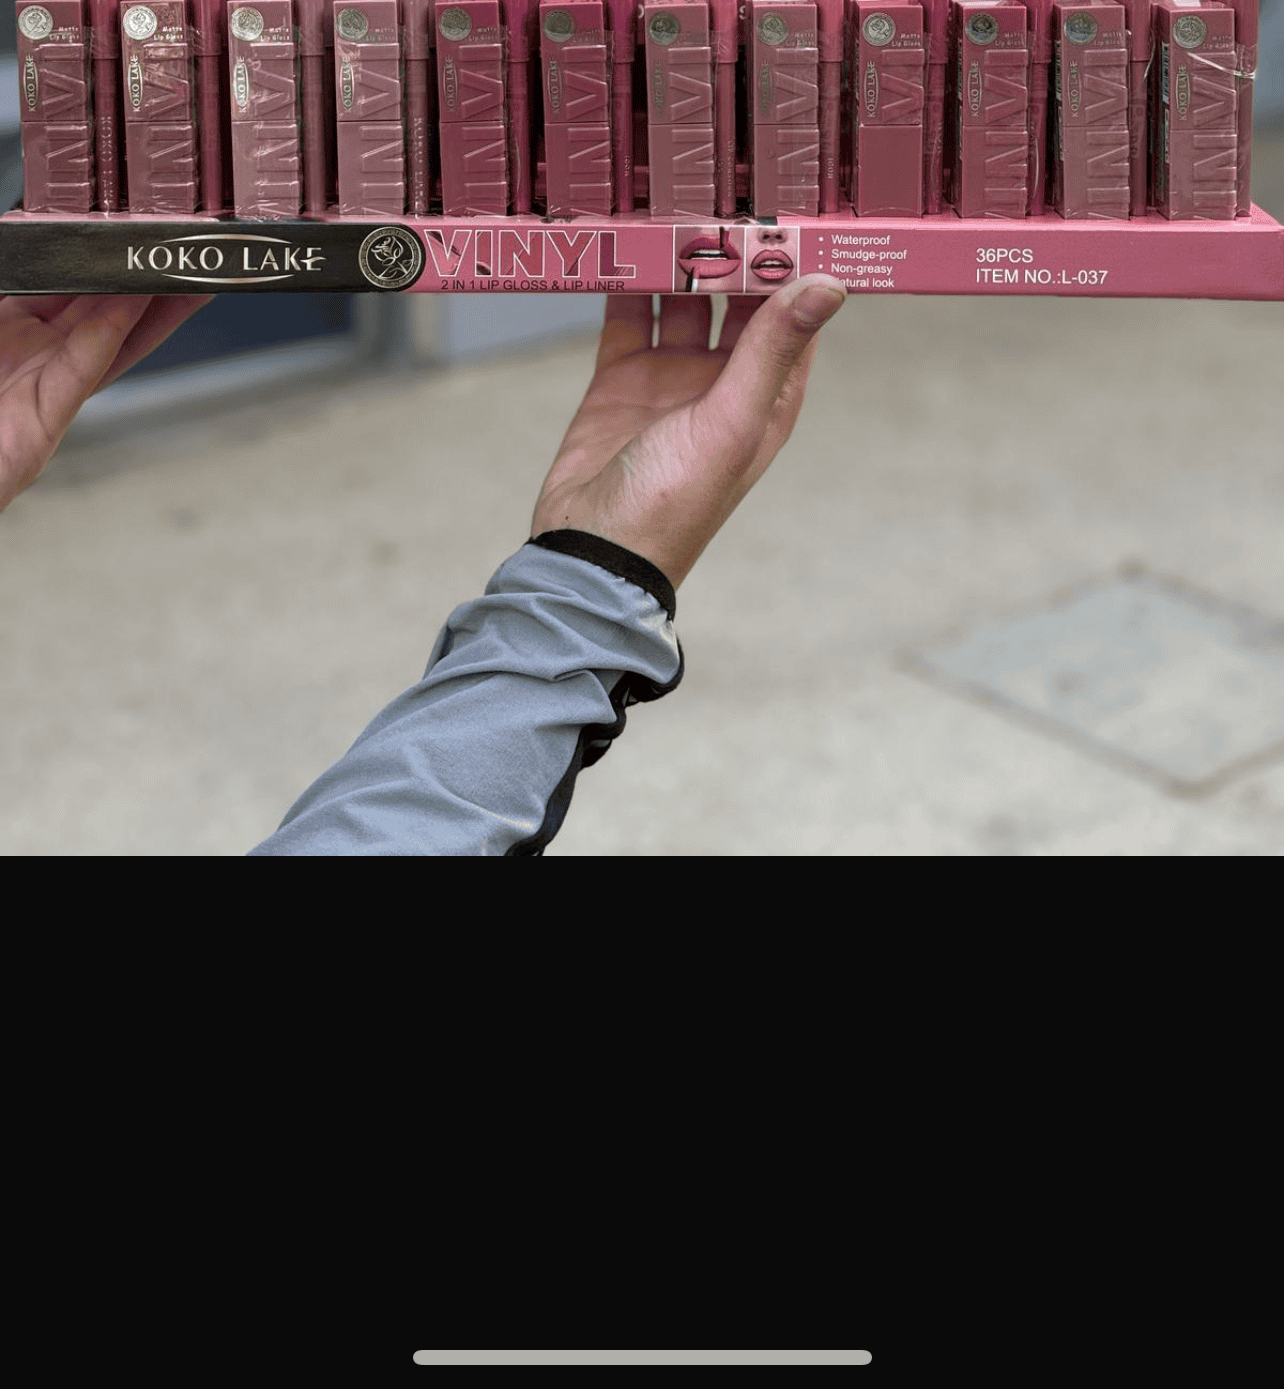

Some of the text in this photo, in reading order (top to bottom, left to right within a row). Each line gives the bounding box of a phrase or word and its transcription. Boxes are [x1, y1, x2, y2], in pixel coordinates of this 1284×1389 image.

[25, 54, 36, 112] KOKO LAKE
[129, 54, 140, 112] KOKO LAKE
[866, 60, 876, 118] KOKO LAKE
[970, 59, 979, 118] KOKO LAKE
[1069, 61, 1079, 118] KOKO LAKE
[1177, 64, 1188, 121] KOKO LAKE
[831, 234, 890, 246] Waterproof
[127, 246, 326, 271] KOKO LAKE
[424, 229, 637, 278] VINYL
[831, 248, 907, 261] Smudge-proof
[976, 248, 1034, 263] 36PCS
[831, 262, 893, 274] Non-greasy
[976, 268, 1108, 285] ITEM NO.:L-037
[441, 280, 625, 291] 2 IN 1 LIP GLOSS & LIP LINER
[840, 276, 895, 288] atural look
